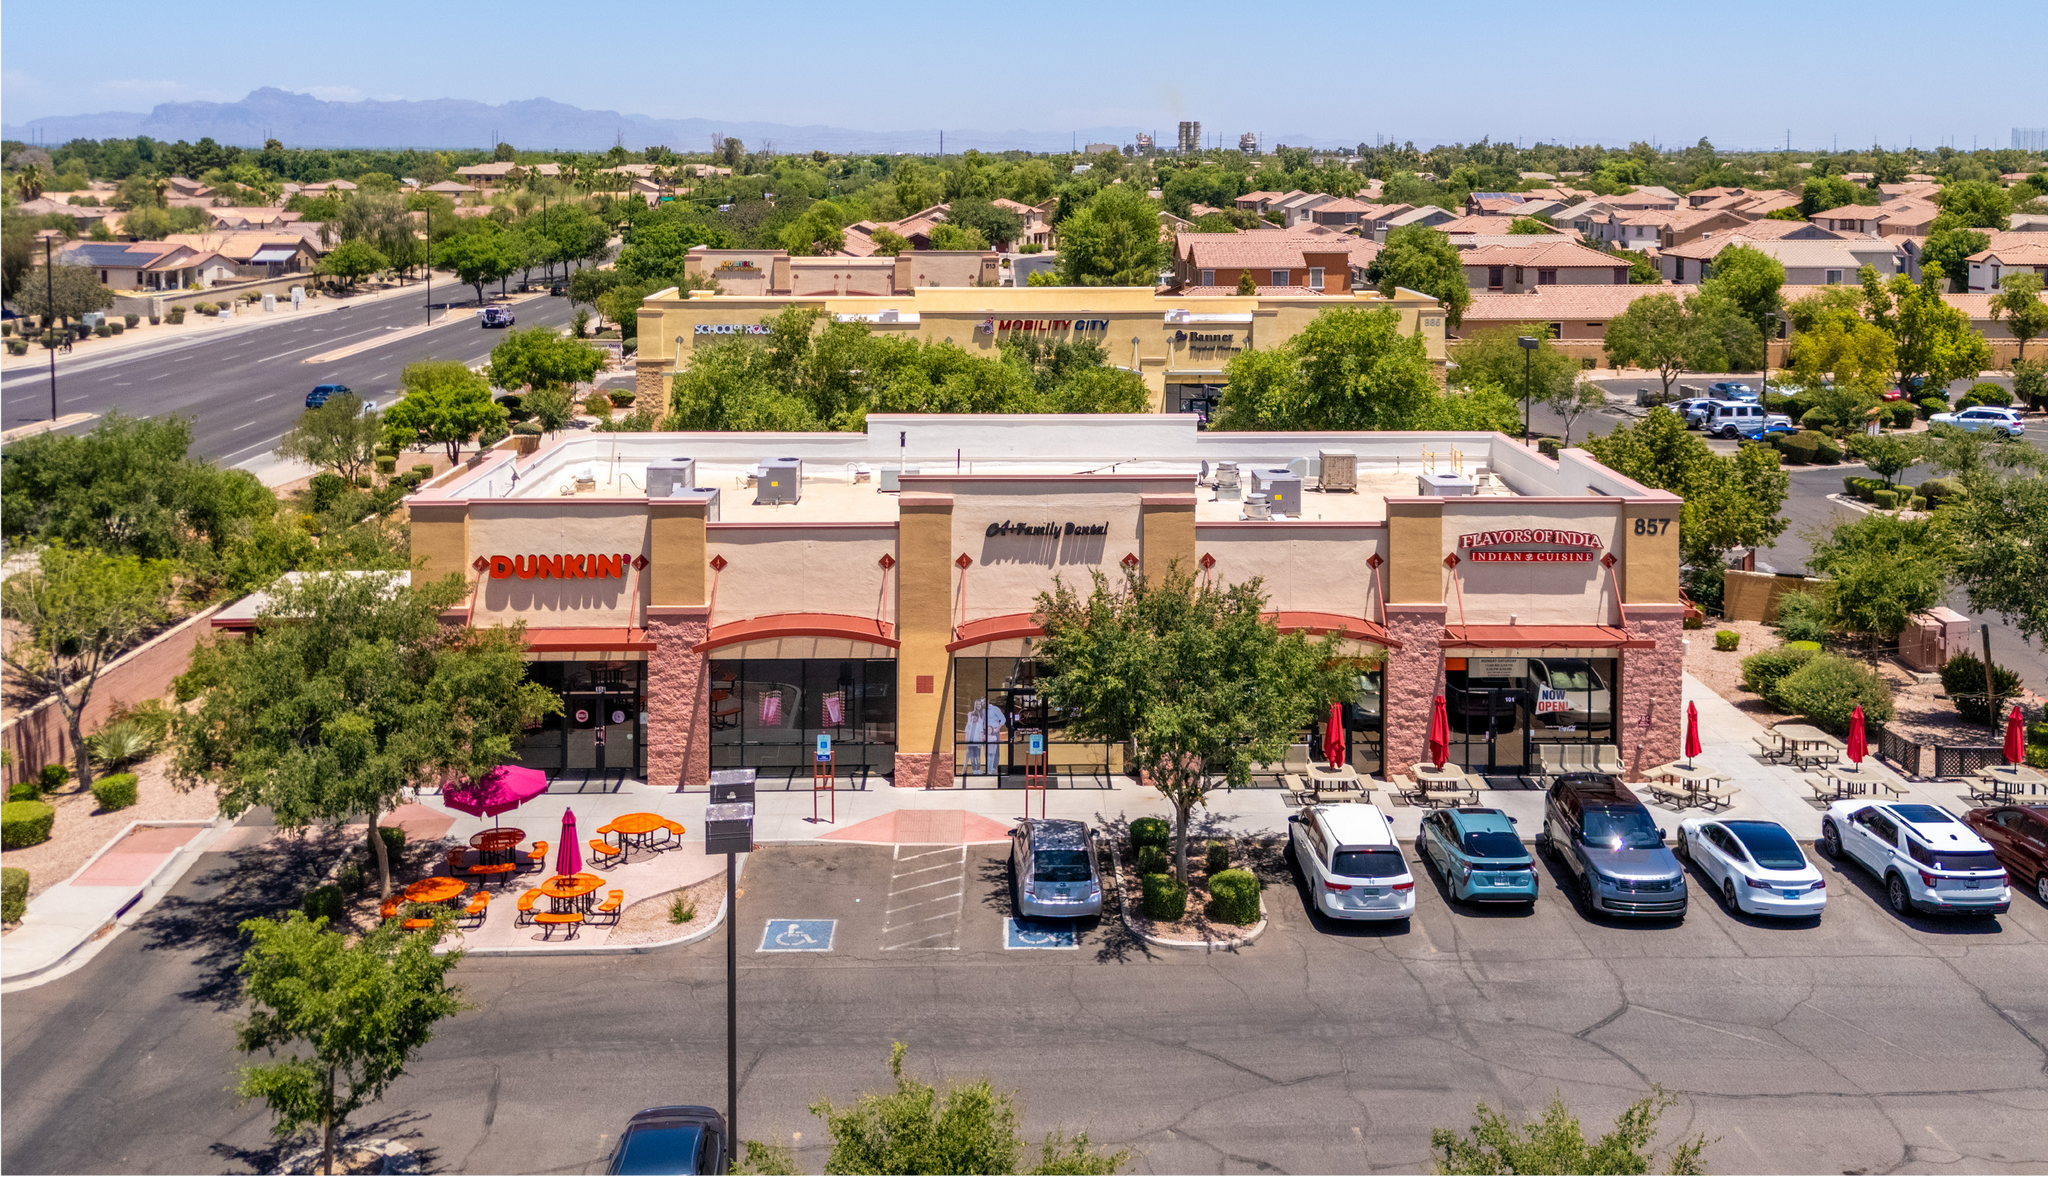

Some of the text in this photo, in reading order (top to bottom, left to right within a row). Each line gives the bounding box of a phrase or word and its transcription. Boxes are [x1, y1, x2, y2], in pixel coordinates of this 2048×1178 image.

[694, 324, 734, 335] SCHOOL
[998, 318, 1110, 331] MOBILITY CITY
[1189, 331, 1234, 342] Banner
[1064, 520, 1109, 535] Dental
[1634, 518, 1671, 535] 857
[1461, 530, 1604, 549] FLAVORS OF INDIA
[1472, 552, 1522, 561] INDIAN
[1537, 552, 1593, 561] CUISINE
[490, 553, 632, 580] DUNKIN'
[1542, 690, 1566, 700] NOW
[1538, 701, 1569, 712] OPEN!
